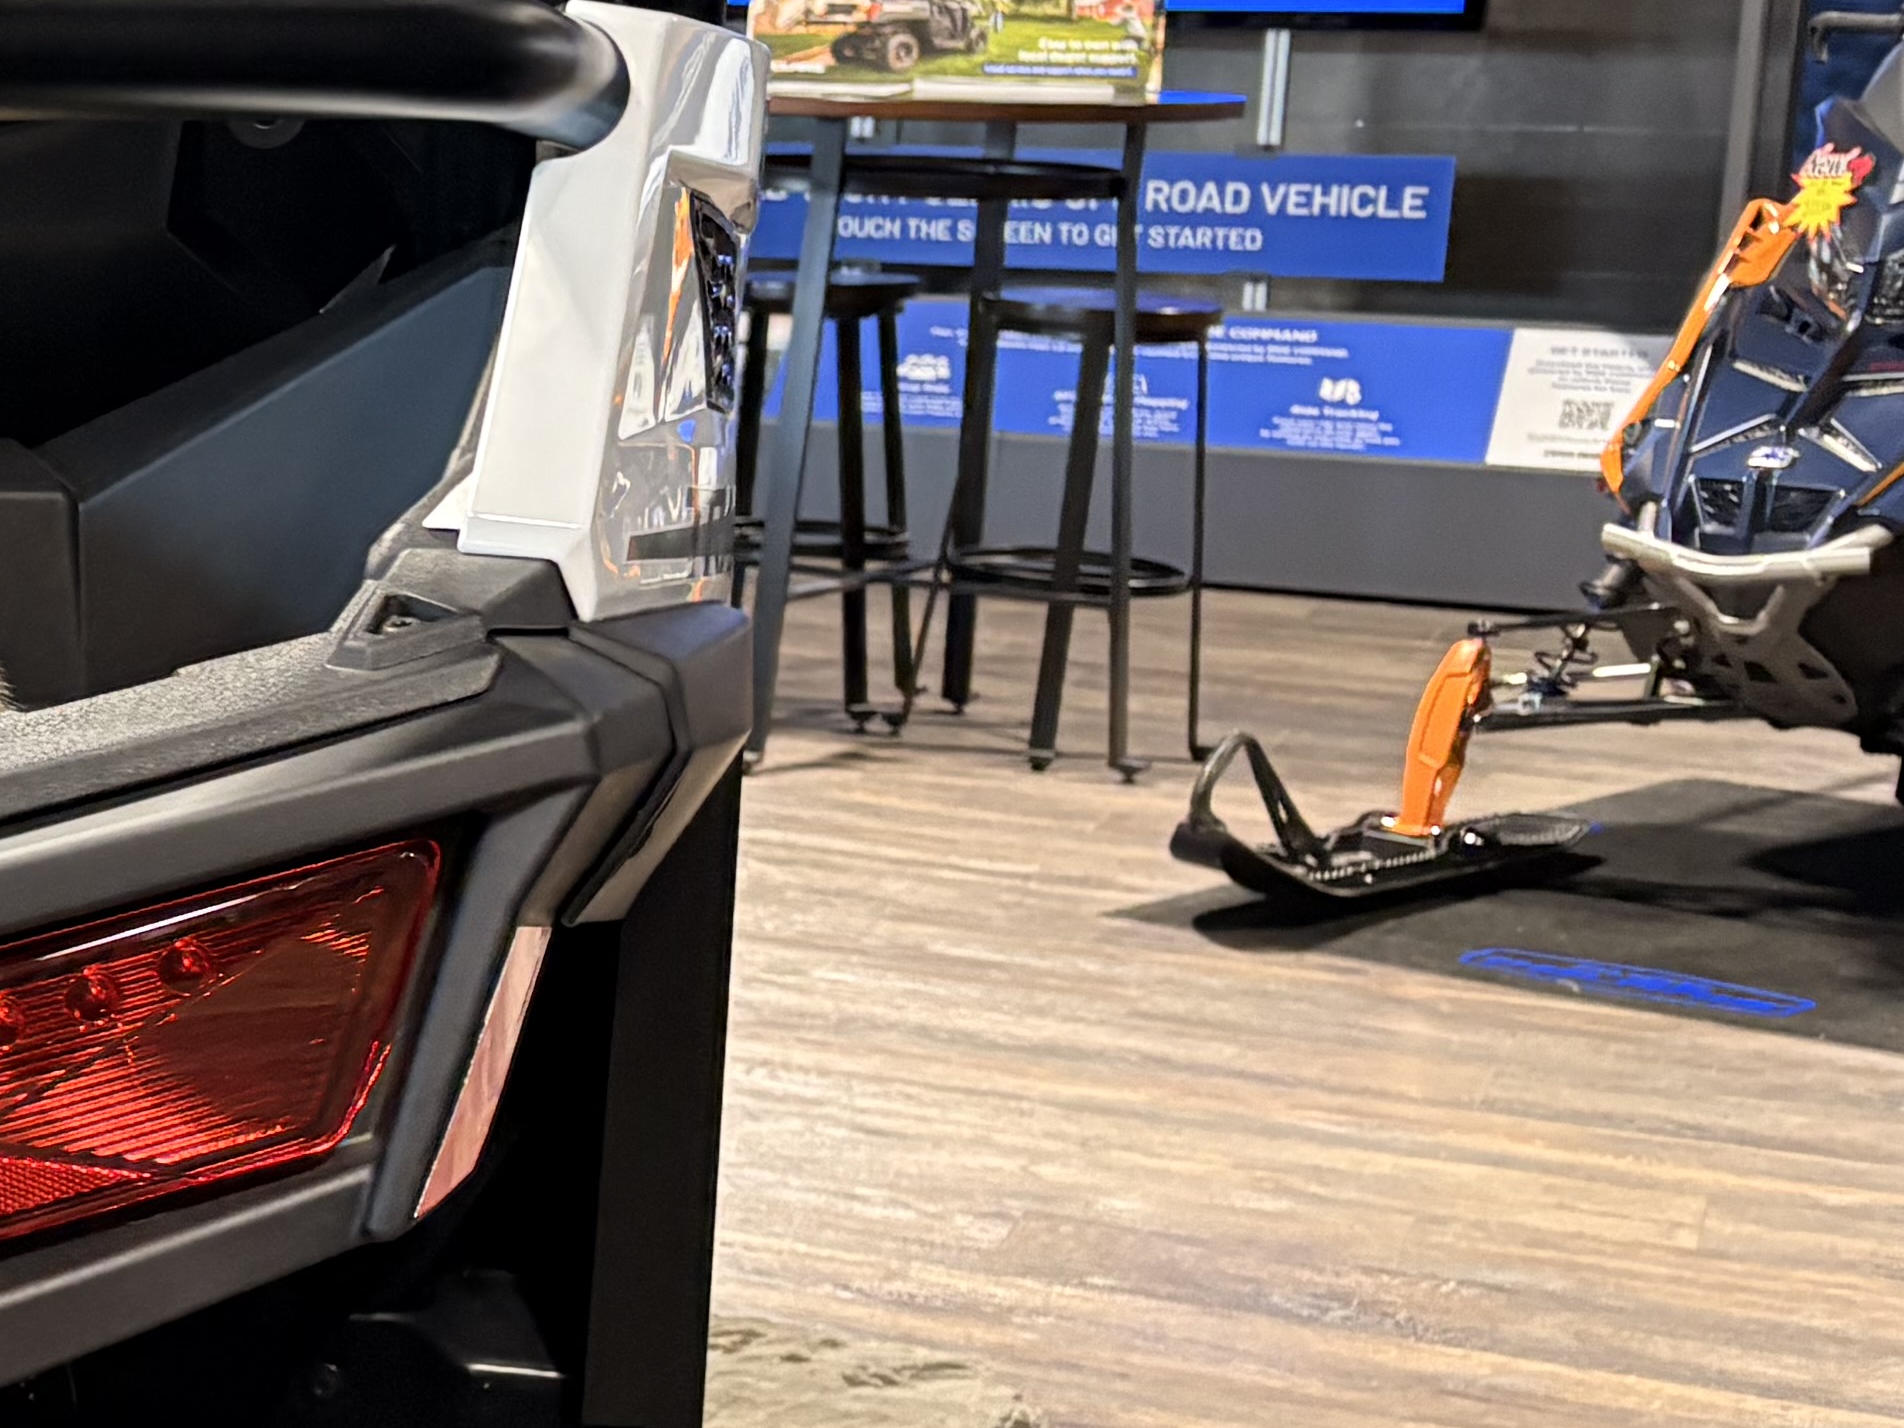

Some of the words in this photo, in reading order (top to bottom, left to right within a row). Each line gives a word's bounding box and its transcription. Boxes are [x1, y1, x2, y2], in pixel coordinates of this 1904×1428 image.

[1145, 179, 1251, 214] ROAD
[1261, 183, 1429, 219] VEHICLE
[838, 218, 901, 239] OUCH
[907, 219, 952, 241] THE
[956, 220, 1051, 245] SEEN
[1059, 222, 1090, 246] TO
[1147, 225, 1263, 252] STARTED
